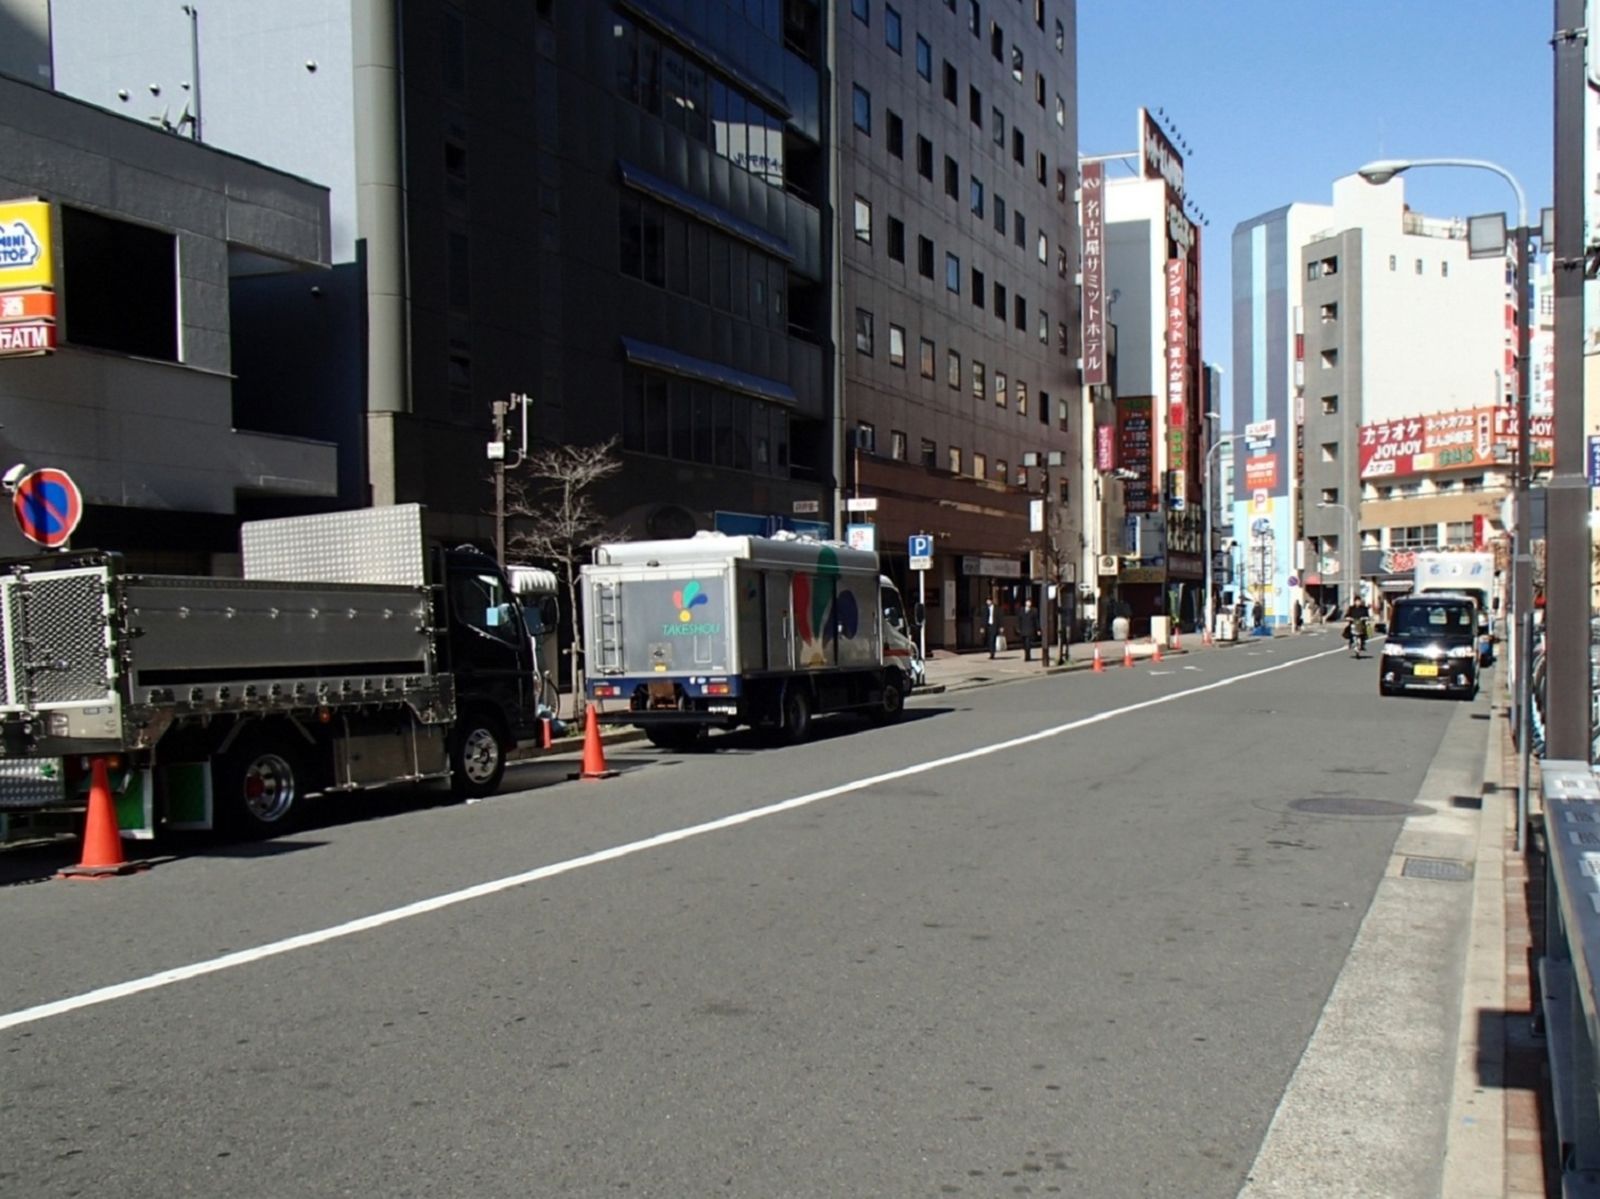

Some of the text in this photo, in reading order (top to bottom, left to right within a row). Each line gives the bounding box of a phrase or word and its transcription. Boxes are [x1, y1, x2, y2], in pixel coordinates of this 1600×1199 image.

[1085, 199, 1101, 370] 名古屋サミットホテル
[1362, 420, 1422, 446] カラオケ
[1374, 440, 1422, 460] JOYJOY
[915, 538, 927, 555] P
[663, 622, 720, 636] TAKESHOU
